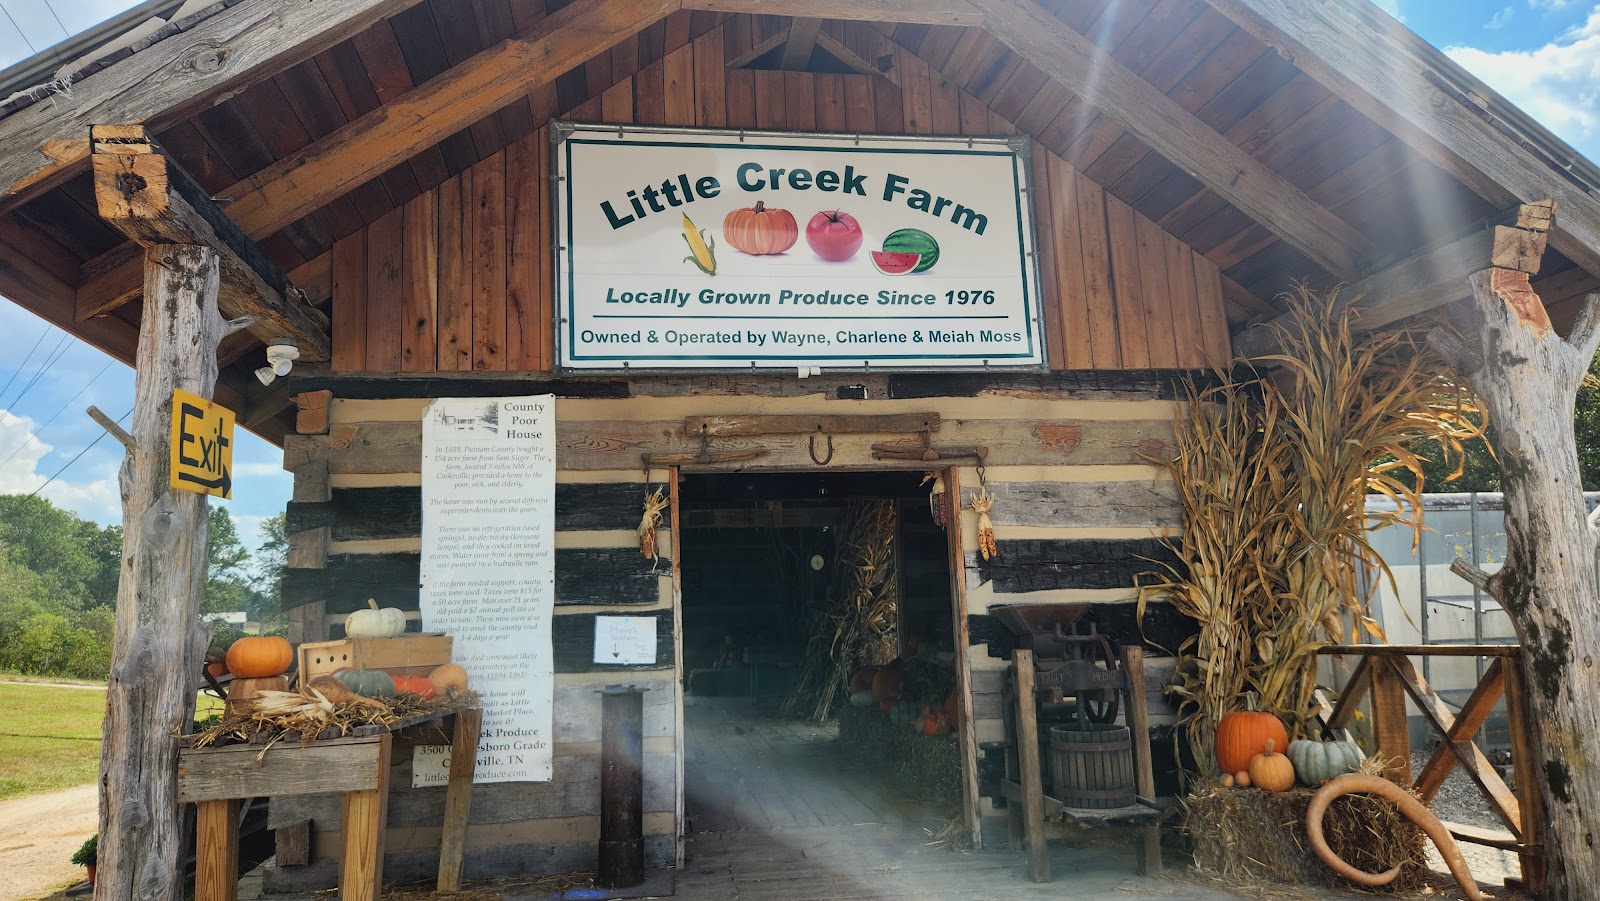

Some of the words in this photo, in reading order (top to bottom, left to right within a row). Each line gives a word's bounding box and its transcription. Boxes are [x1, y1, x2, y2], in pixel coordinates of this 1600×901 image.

[600, 173, 721, 230] Little
[736, 162, 868, 197] Creek
[882, 173, 988, 236] Farm
[606, 288, 691, 308] Locally
[698, 289, 771, 304] Grown
[778, 290, 869, 305] Produce
[876, 290, 936, 305] Since
[945, 290, 995, 305] 1976
[581, 330, 641, 344] Owned
[647, 330, 659, 344] &
[665, 330, 741, 346] Operated
[748, 330, 766, 346] by
[772, 330, 831, 346] Wayne,
[836, 330, 907, 344] Charlene
[912, 330, 924, 344] &
[929, 330, 974, 344] Meiah
[980, 330, 1022, 344] Moss
[504, 402, 544, 414] County
[512, 416, 538, 425] Poor
[180, 402, 228, 476] Exit
[507, 430, 542, 439] House
[493, 560, 523, 568] hydraulic
[496, 728, 539, 738] Produce
[420, 745, 444, 755] 3500
[514, 740, 546, 750] Grade
[507, 755, 524, 764] TN
